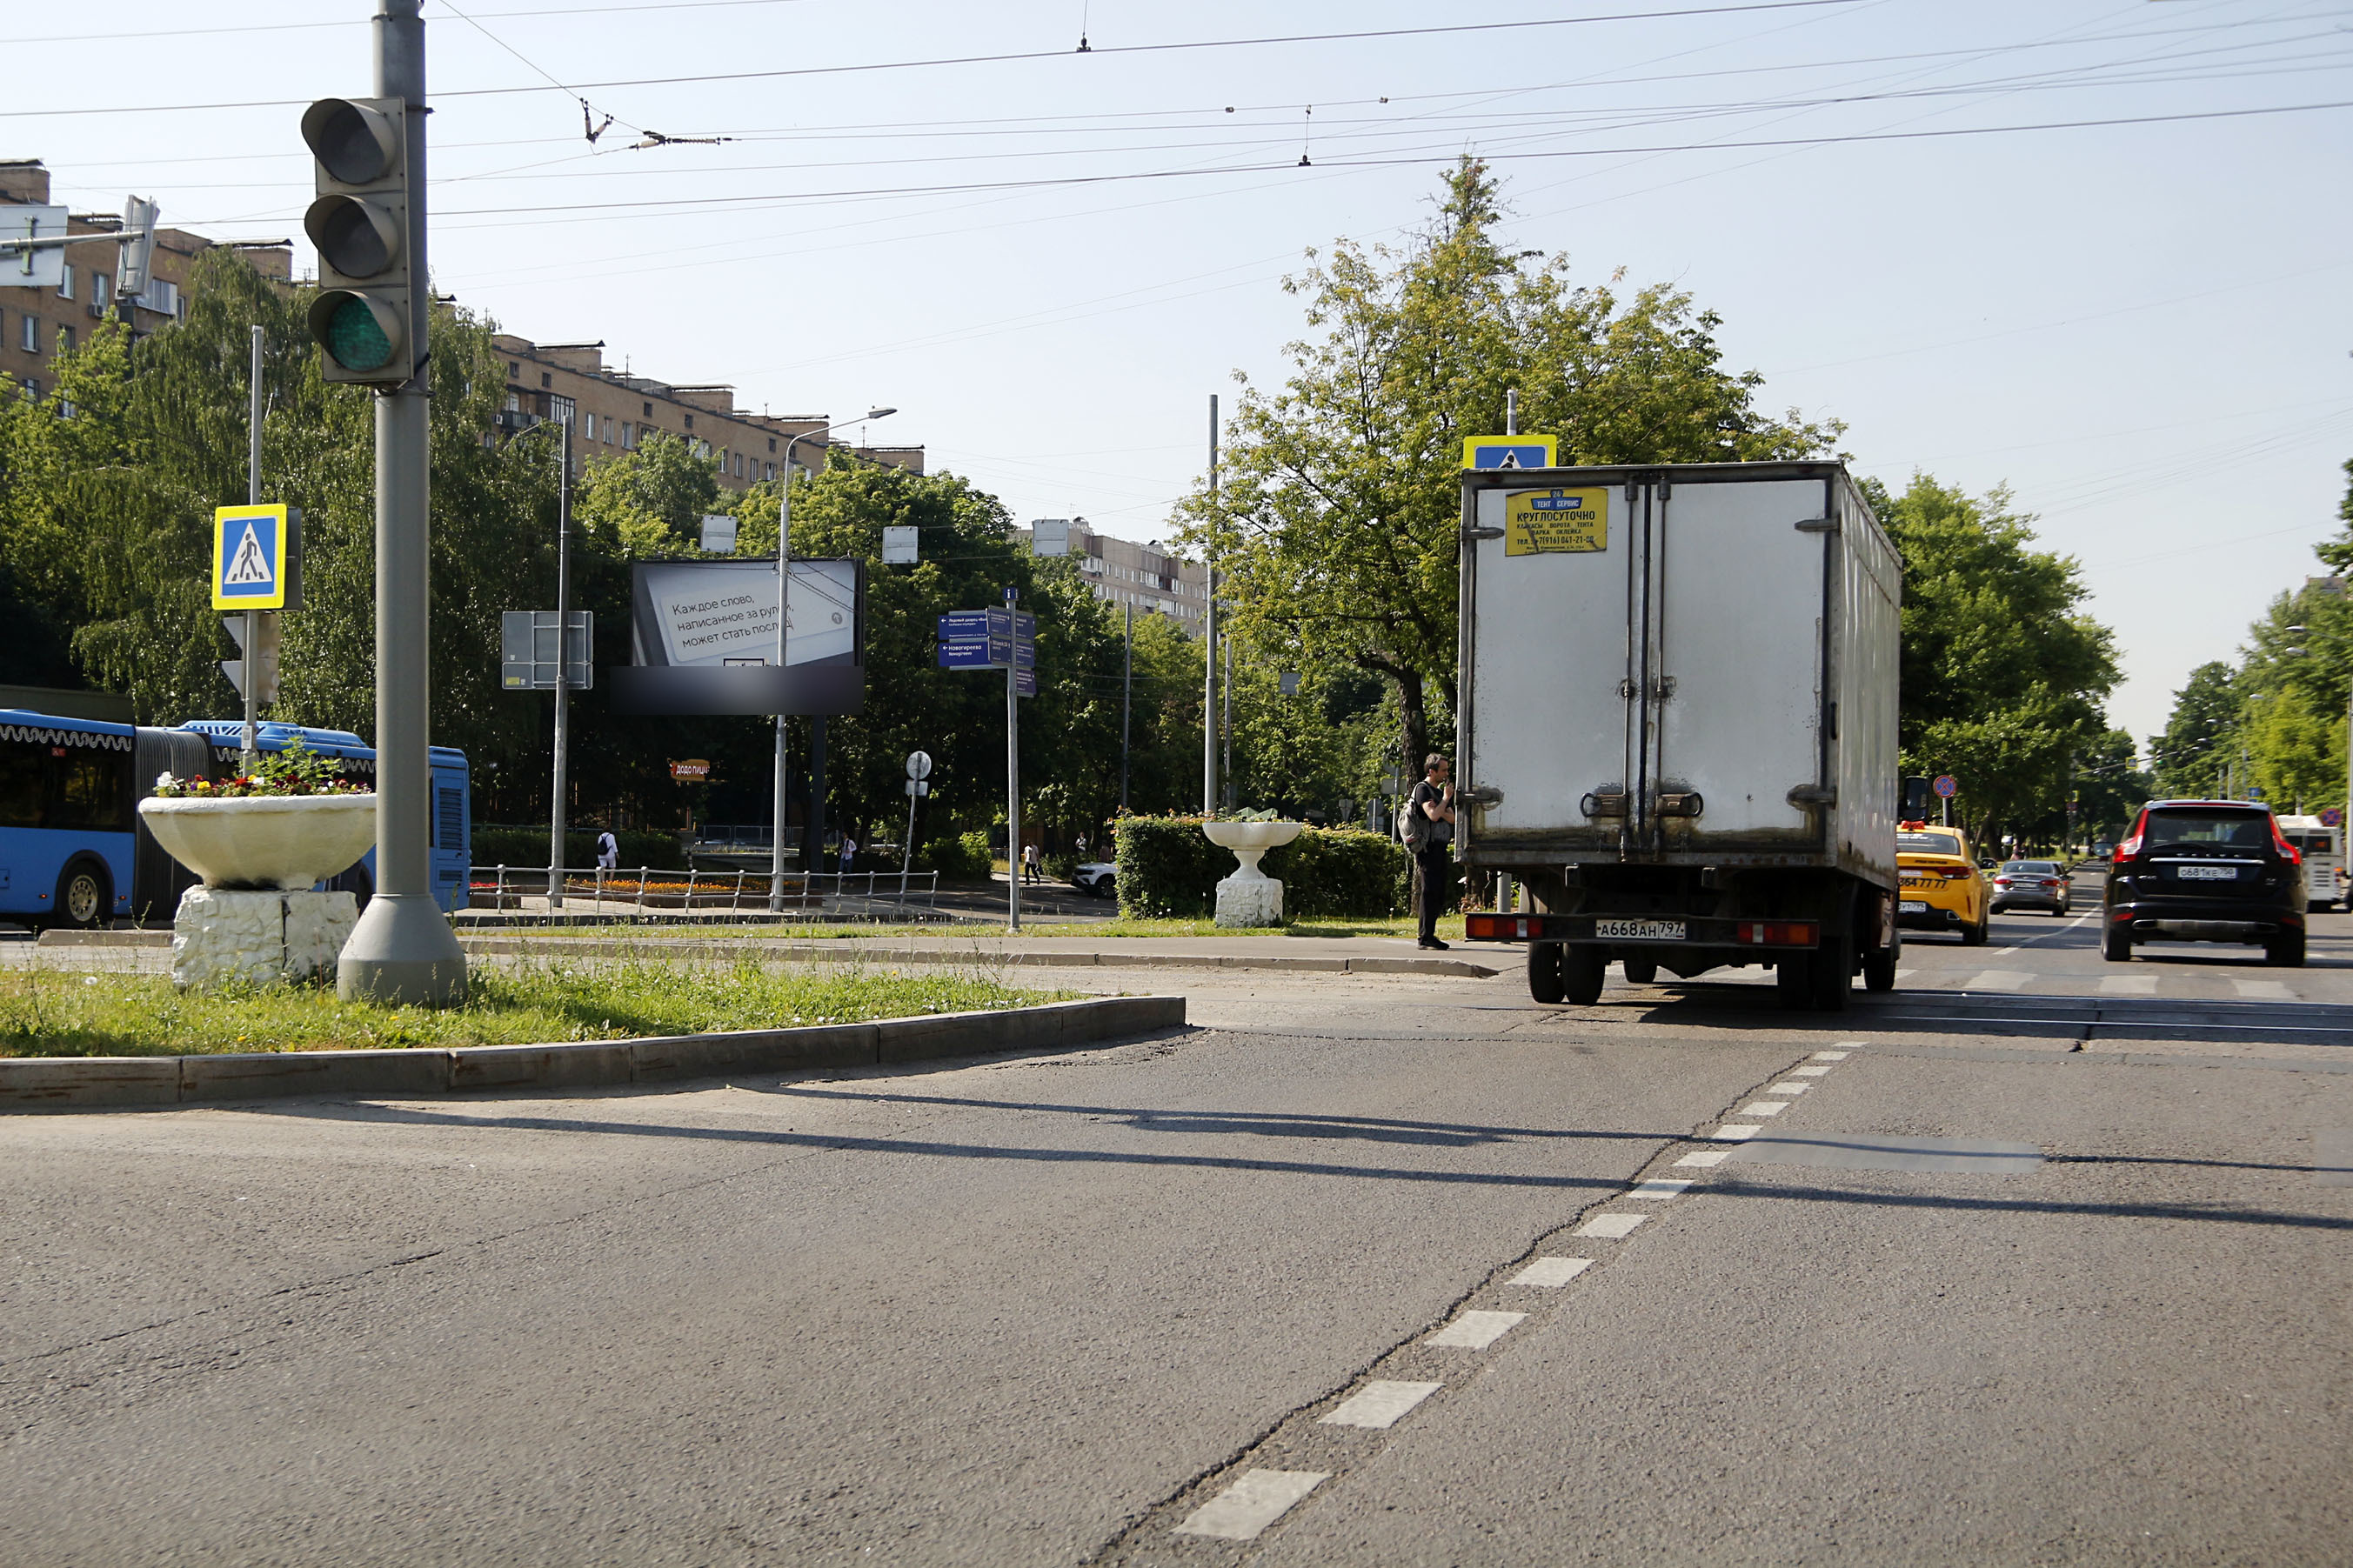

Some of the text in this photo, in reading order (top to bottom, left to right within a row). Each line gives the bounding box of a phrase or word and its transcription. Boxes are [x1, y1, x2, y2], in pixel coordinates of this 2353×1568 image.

[1556, 499, 1579, 508] СЕРВИС
[1517, 511, 1595, 522] КРУГЛОСУТОЧНО
[672, 595, 755, 616] Каждое слово,
[678, 612, 745, 631] написанное
[746, 611, 759, 619] за
[682, 633, 719, 648] может
[722, 629, 752, 641] стать
[677, 765, 692, 775] ДОДО
[1920, 878, 1933, 888] 77
[1935, 879, 1948, 889] 77
[1601, 921, 1681, 937] А668АН 797
